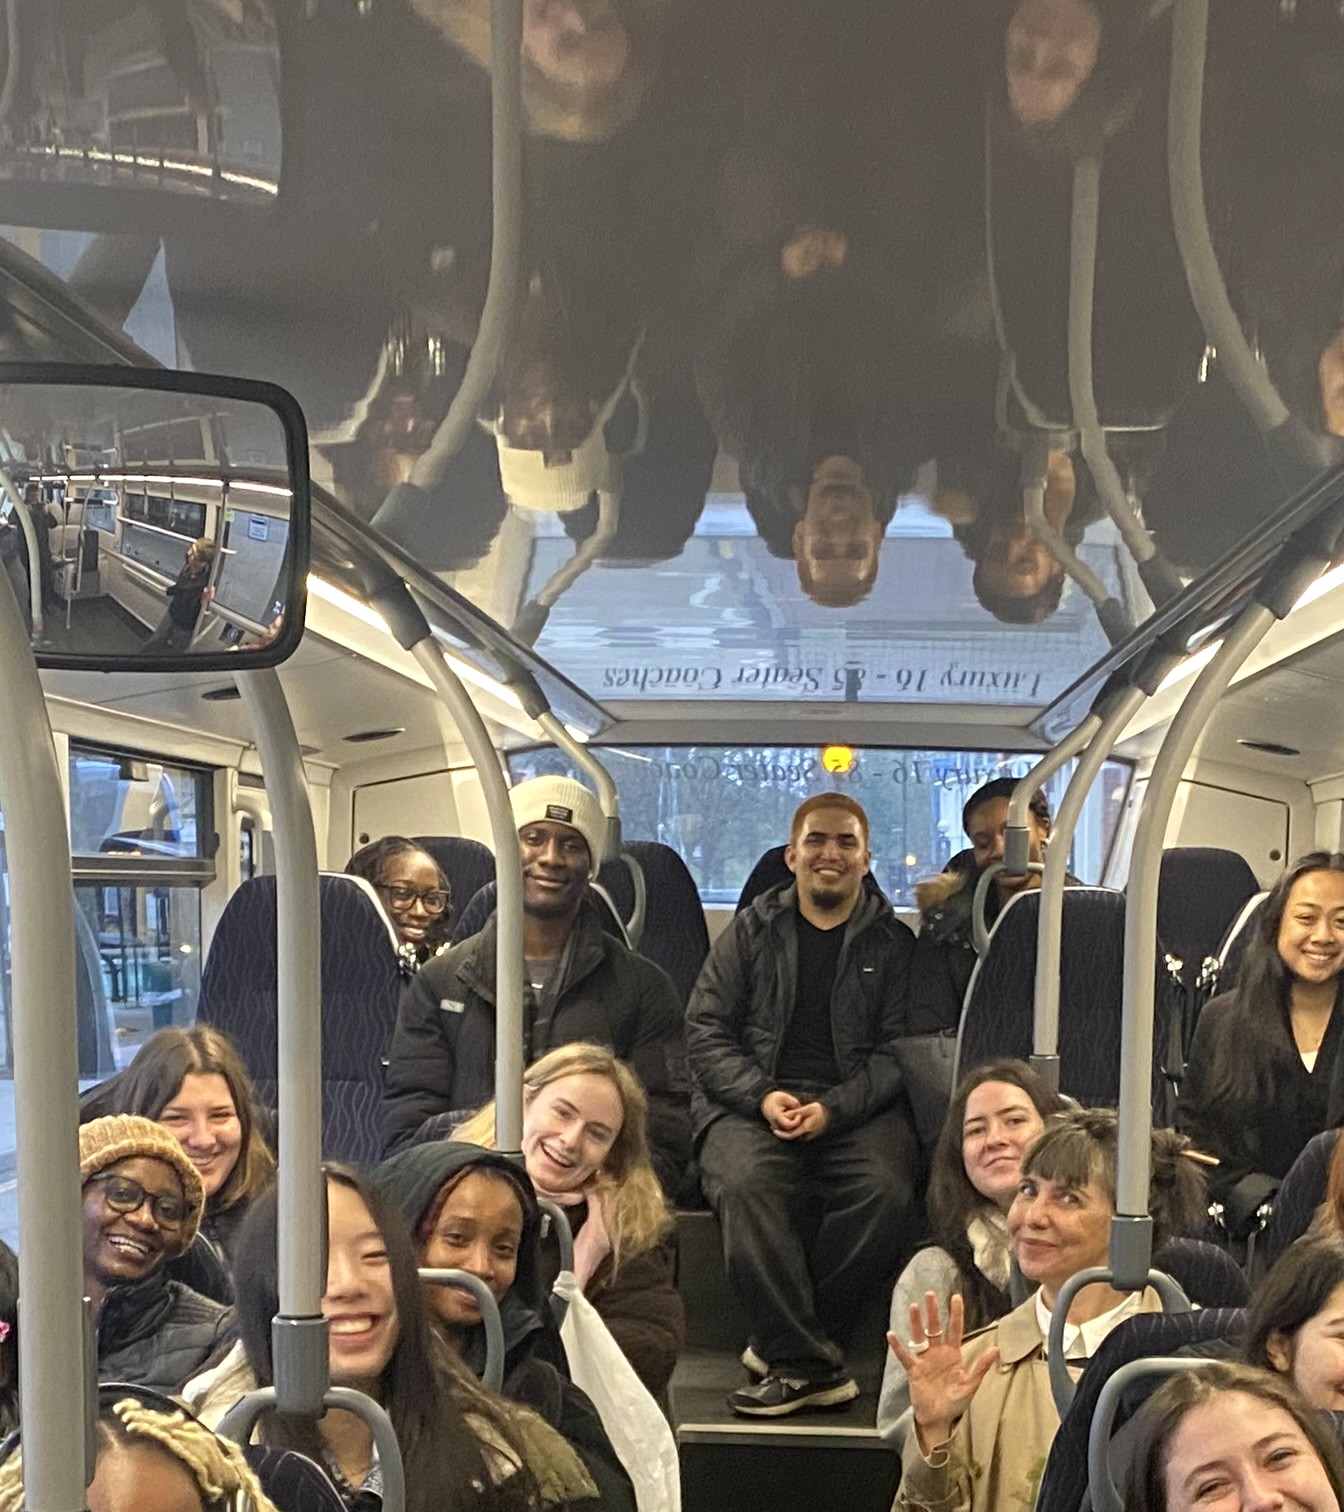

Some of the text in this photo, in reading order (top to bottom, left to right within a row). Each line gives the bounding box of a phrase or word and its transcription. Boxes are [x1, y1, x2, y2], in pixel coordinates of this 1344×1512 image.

[603, 667, 722, 692] Coaches
[731, 666, 824, 692] Seater
[896, 668, 928, 692] 16
[940, 662, 1042, 697] Luxury
